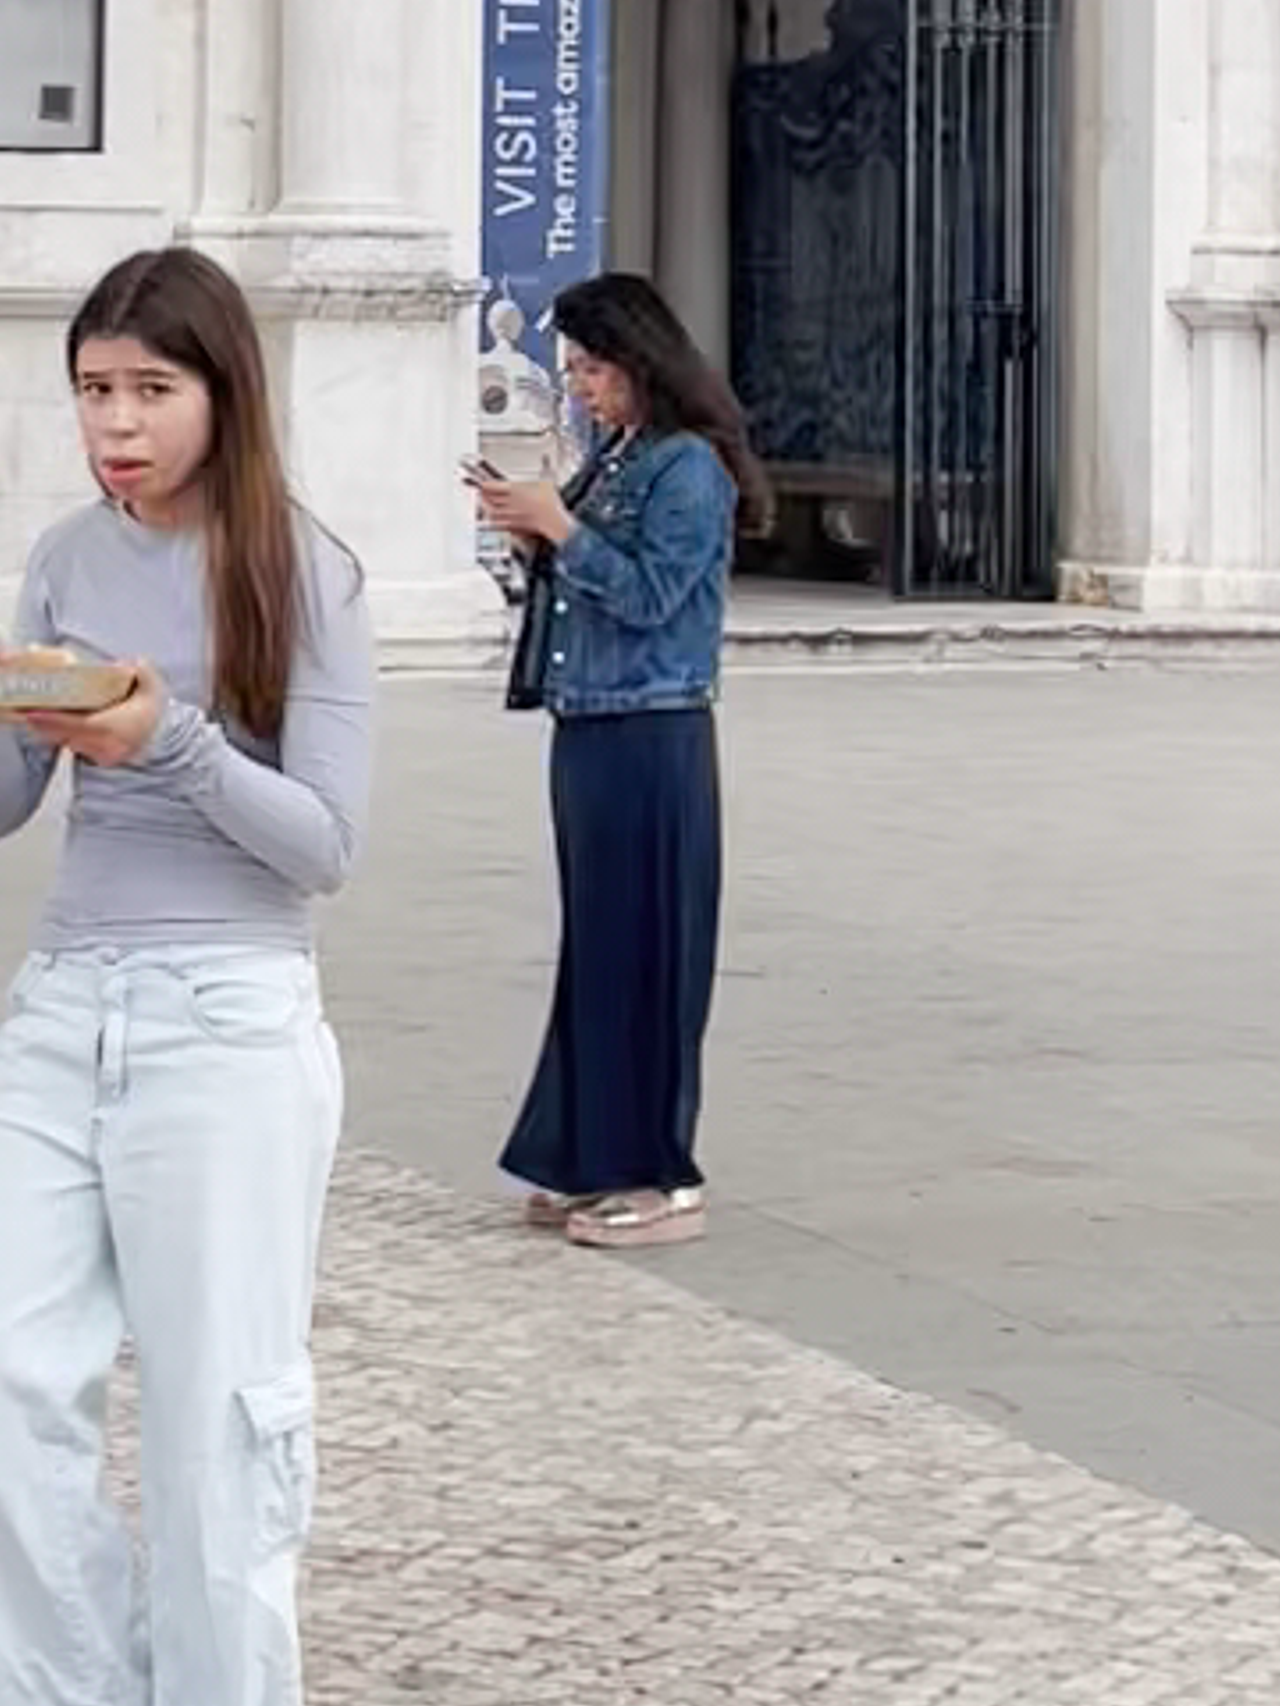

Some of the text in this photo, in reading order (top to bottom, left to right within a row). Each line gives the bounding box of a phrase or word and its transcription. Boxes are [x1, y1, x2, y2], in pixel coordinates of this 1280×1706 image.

[493, 76, 538, 217] VISIT
[551, 100, 579, 188] most
[546, 192, 577, 259] The
